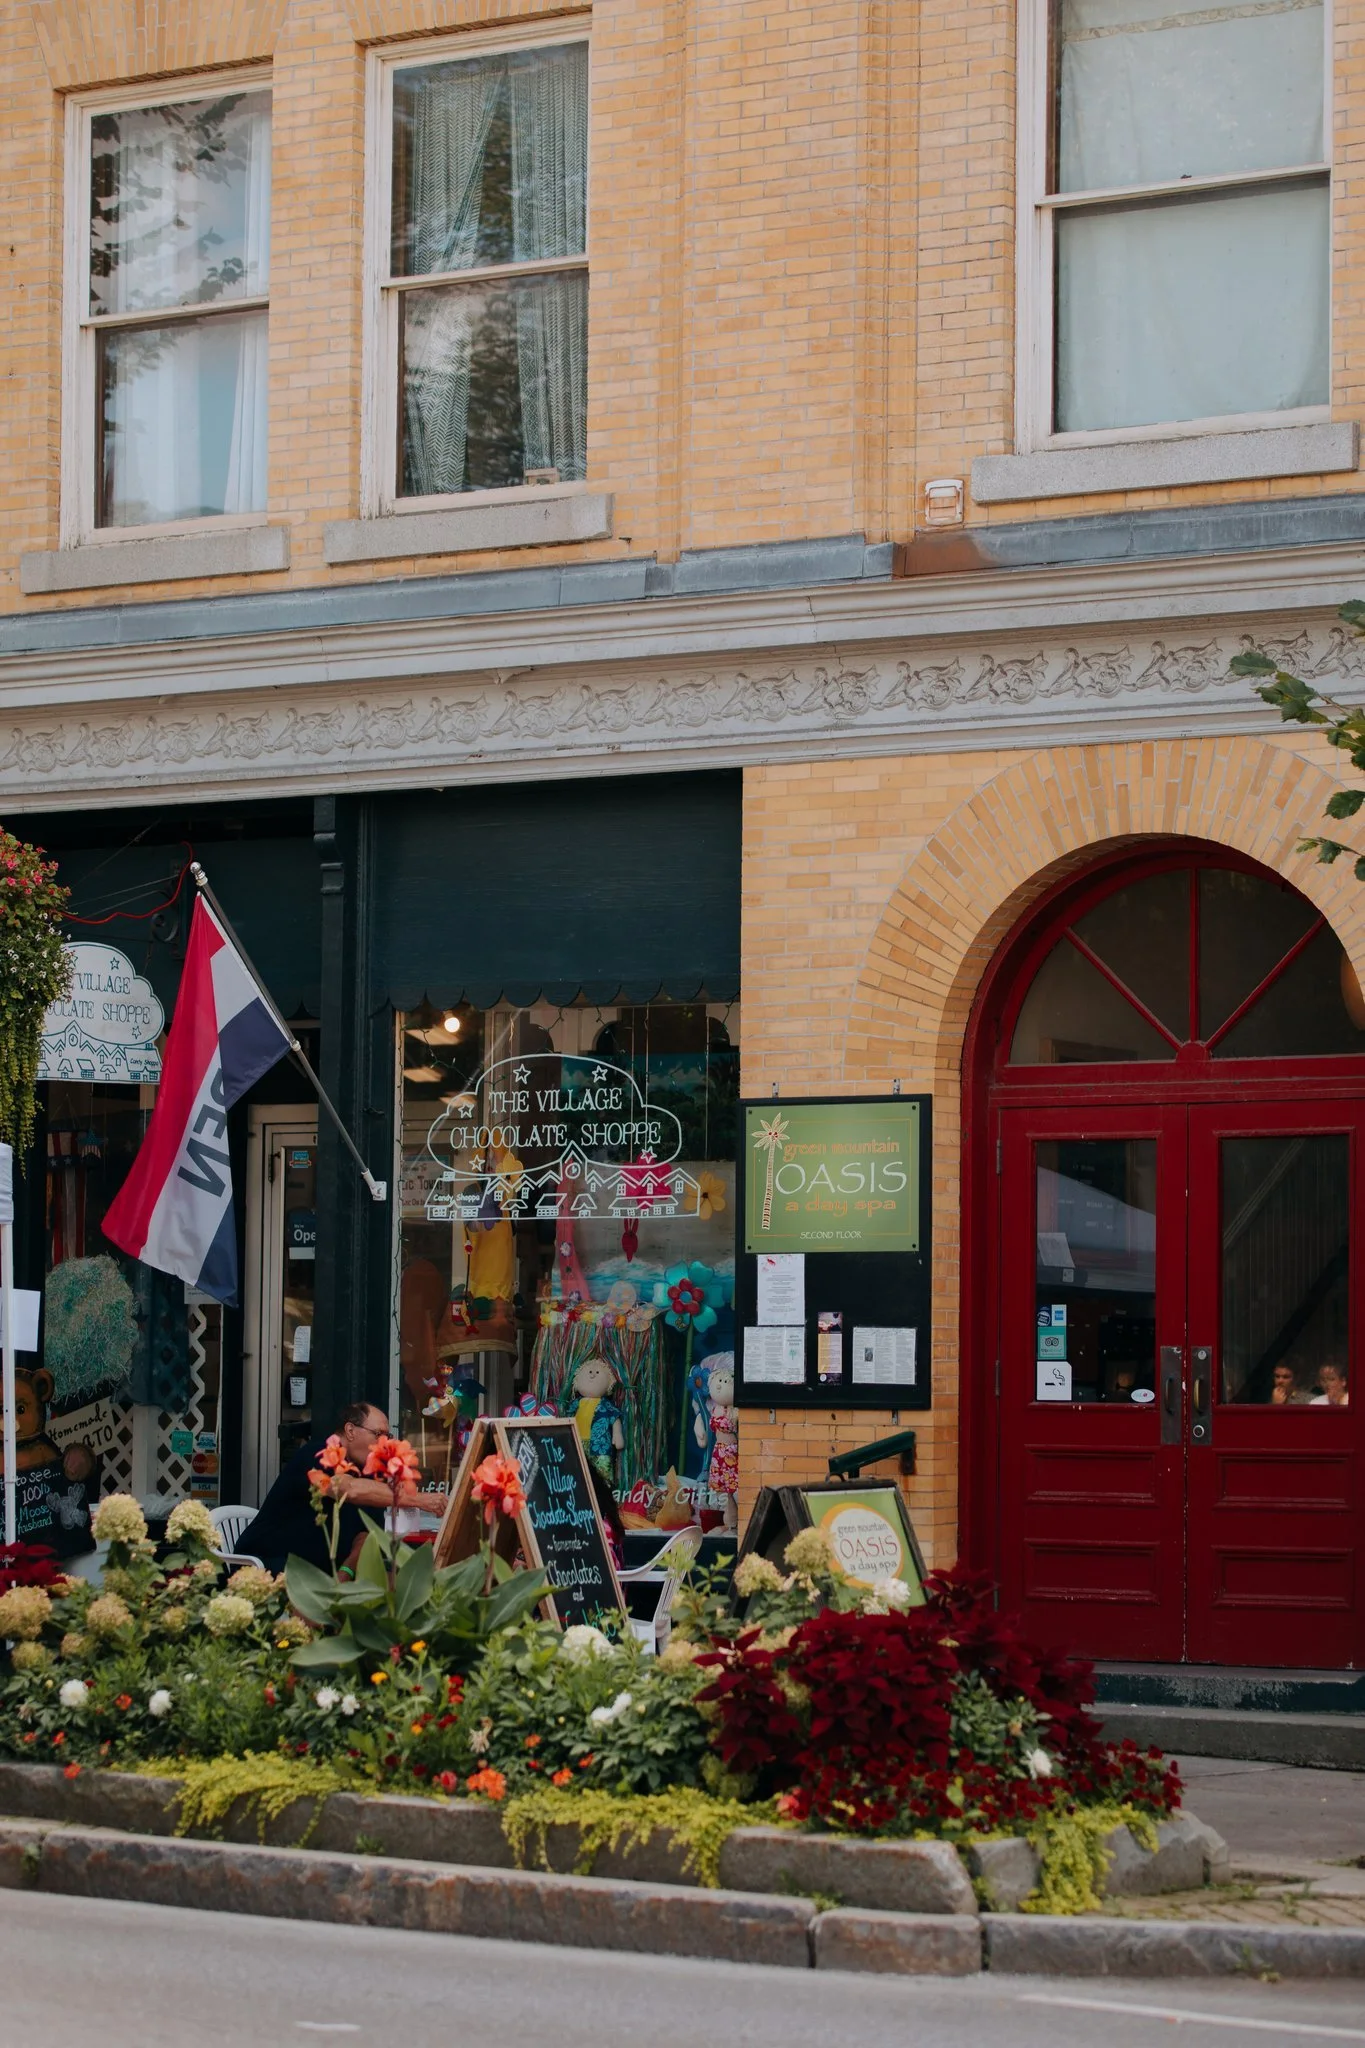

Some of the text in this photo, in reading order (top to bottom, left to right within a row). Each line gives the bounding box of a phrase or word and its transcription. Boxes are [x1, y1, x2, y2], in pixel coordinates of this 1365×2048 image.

[73, 973, 131, 995] VILLAGE
[102, 1002, 151, 1025] SHOPPE
[489, 1087, 623, 1114] THE VILLAGE
[450, 1121, 662, 1150] CHOCOLATE SHOPPE
[783, 1136, 900, 1163] green mountain
[775, 1161, 908, 1195] OASIS
[785, 1192, 897, 1218] a day spa
[799, 1230, 863, 1240] SECOND FLOOR
[49, 1402, 108, 1441] Homemade
[540, 1438, 566, 1463] The
[541, 1465, 577, 1504] Village
[611, 1484, 729, 1508] andy Gifts
[19, 1504, 50, 1522] Moose
[840, 1535, 898, 1559] OASIS
[548, 1558, 603, 1588] Chocolates
[850, 1559, 898, 1573] a day spa
